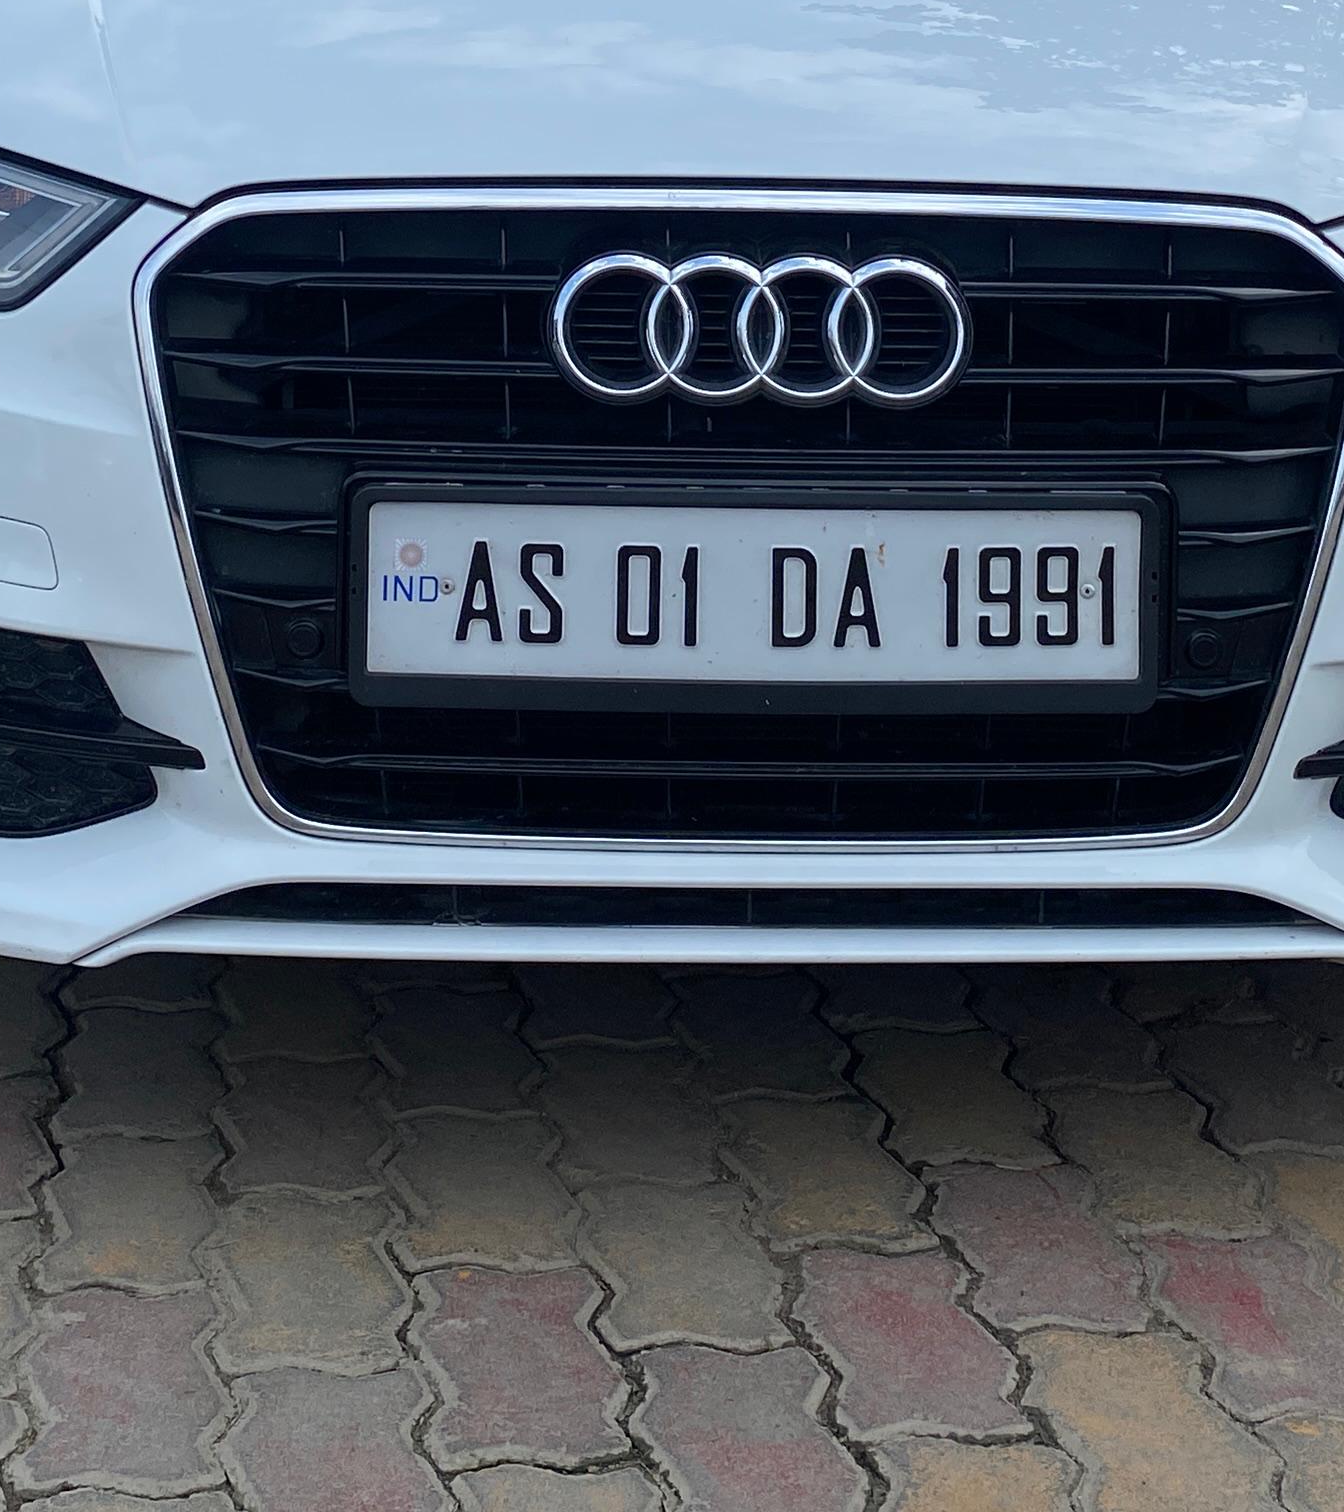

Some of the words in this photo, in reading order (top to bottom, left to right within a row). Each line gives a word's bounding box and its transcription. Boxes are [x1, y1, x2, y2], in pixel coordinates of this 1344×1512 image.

[382, 575, 439, 603] IND
[454, 540, 566, 645] AS
[616, 543, 699, 647] 01
[771, 546, 882, 649] DA
[942, 545, 1116, 648] 1991
